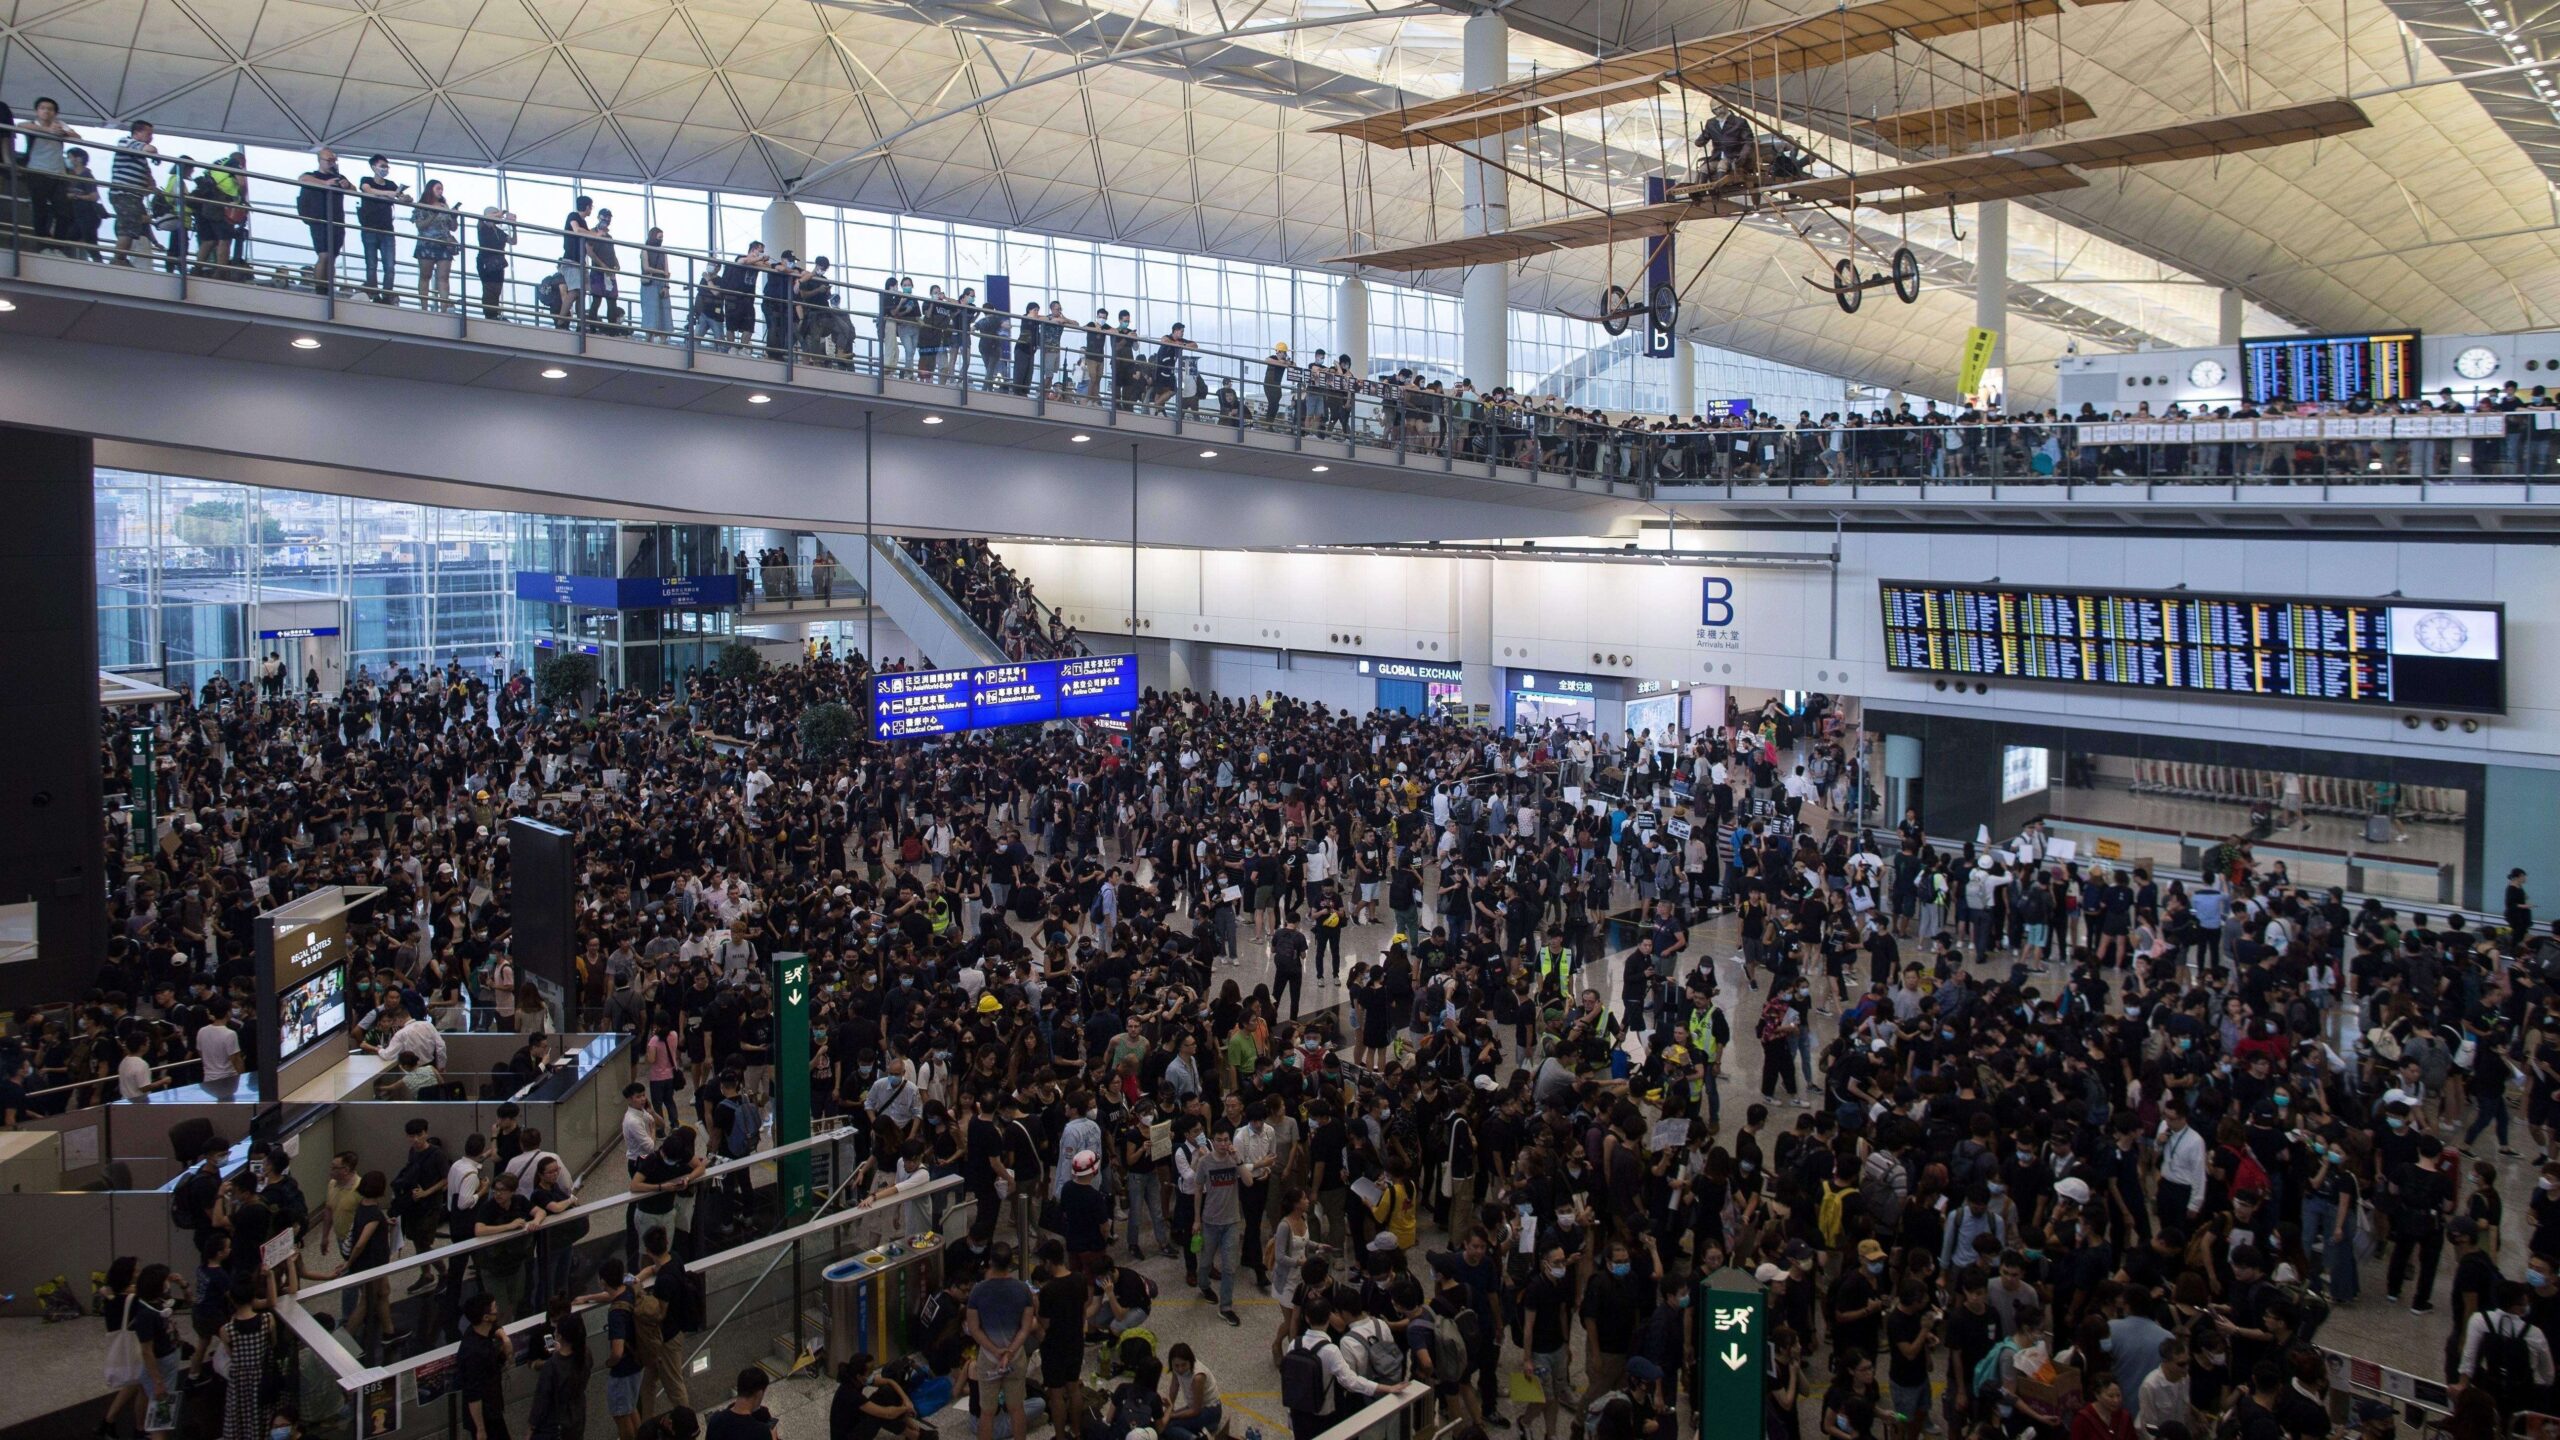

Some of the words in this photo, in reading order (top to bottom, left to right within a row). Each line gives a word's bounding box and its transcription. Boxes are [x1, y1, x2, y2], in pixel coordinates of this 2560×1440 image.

[662, 588, 671, 596] L6
[1702, 576, 1734, 626] B
[1696, 628, 1740, 640] 接機大堂
[1696, 640, 1724, 648] Arrivals
[998, 666, 1020, 676] 停車場
[1020, 667, 1026, 680] 1
[1378, 663, 1418, 676] GLOBAL
[912, 682, 953, 692] AsiaWorld-Expo
[905, 706, 918, 714] Light
[906, 716, 938, 727] 醫療中心
[906, 726, 926, 734] Medical
[291, 949, 310, 964] REGAL
[310, 937, 332, 954] HOTELS
[318, 1002, 332, 1015] REGAL
[364, 1381, 382, 1394] SOS
